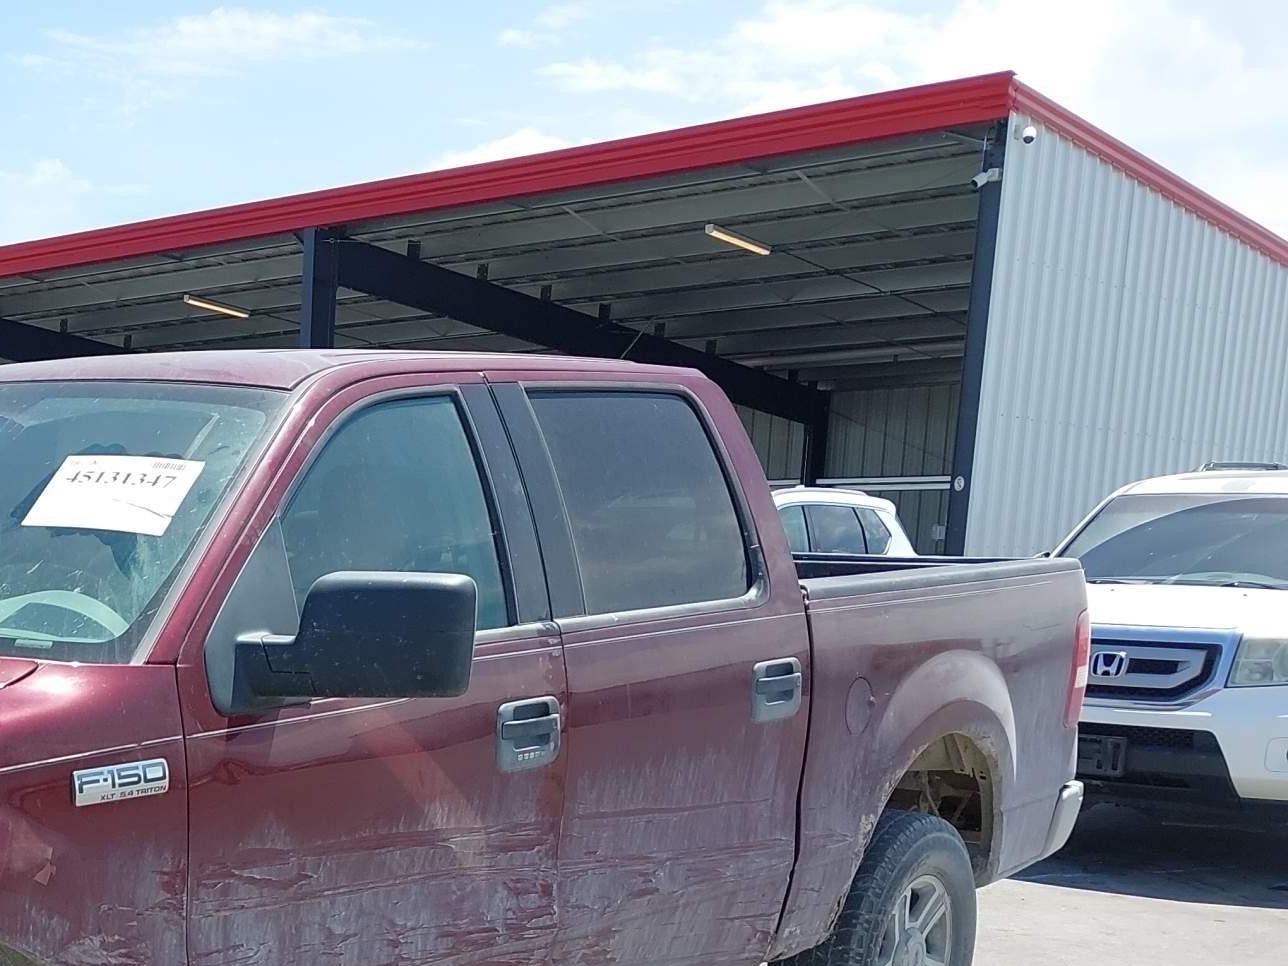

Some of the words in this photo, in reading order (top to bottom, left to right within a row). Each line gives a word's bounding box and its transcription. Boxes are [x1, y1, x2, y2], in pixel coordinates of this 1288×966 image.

[66, 470, 177, 488] 45131347
[77, 761, 167, 794] F-150
[100, 792, 116, 801] XLT
[135, 784, 167, 796] TRITON
